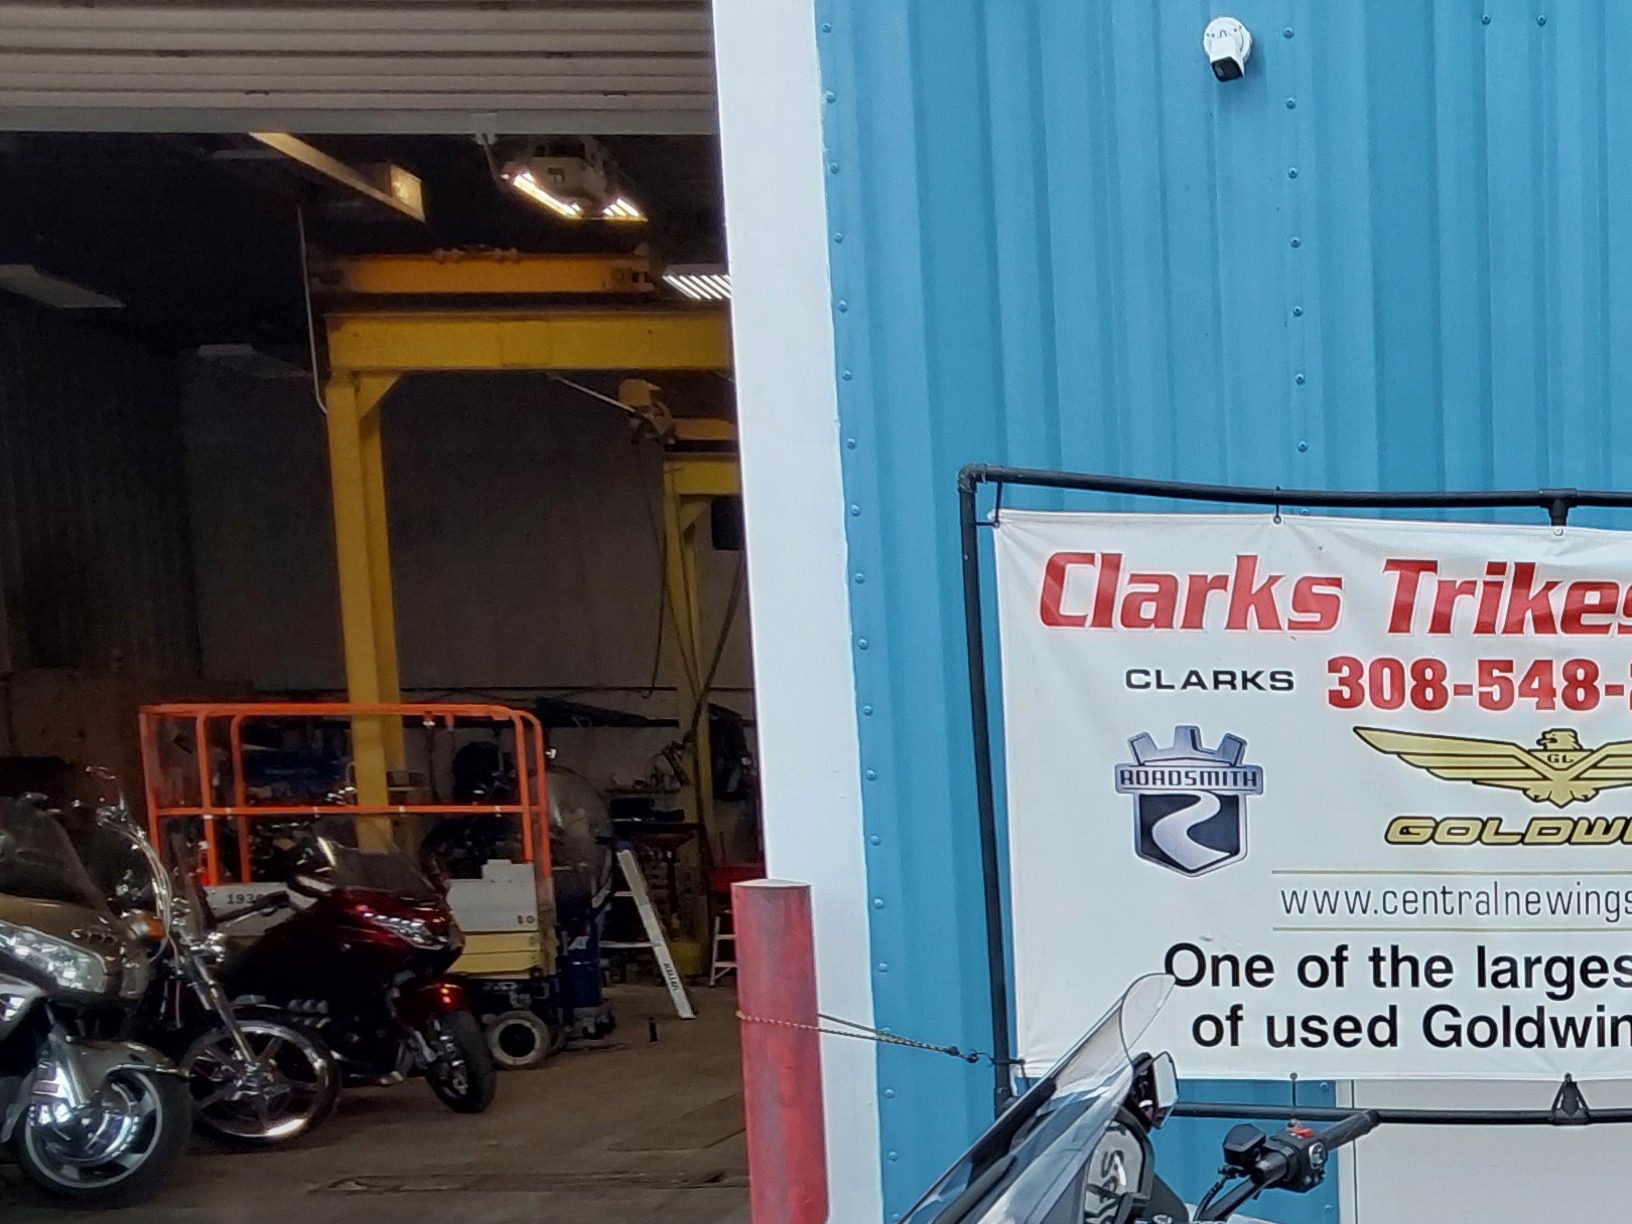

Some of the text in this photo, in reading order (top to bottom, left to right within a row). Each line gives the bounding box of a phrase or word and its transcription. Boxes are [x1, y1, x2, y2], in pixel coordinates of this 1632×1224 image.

[1039, 552, 1344, 632] Clarks
[1125, 669, 1295, 691] CLARKS
[1547, 754, 1574, 763] GL
[1120, 770, 1257, 787] ROADSMITH
[1164, 942, 1275, 988] One
[1297, 943, 1349, 989] of
[1368, 944, 1454, 989] the
[1192, 1003, 1244, 1048] of
[1266, 1004, 1399, 1049] used
